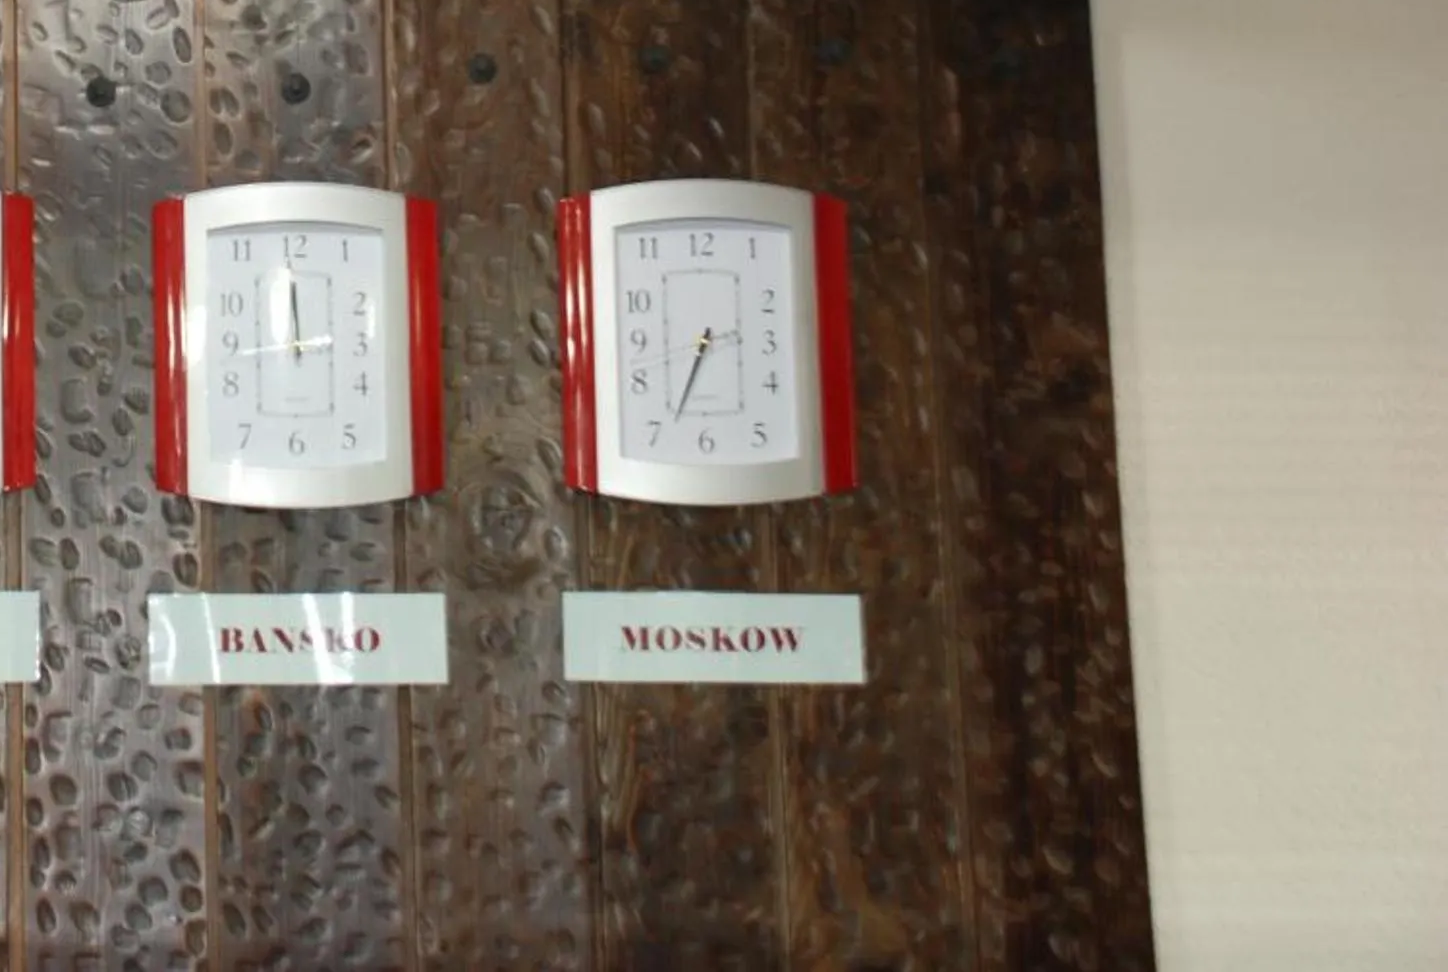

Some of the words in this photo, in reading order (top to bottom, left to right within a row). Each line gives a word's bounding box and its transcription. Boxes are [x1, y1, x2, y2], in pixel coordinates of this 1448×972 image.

[231, 239, 252, 262] 11
[282, 235, 307, 259] 12
[341, 239, 349, 262] 1
[638, 237, 658, 259] 11
[688, 233, 715, 257] 12
[748, 237, 757, 259] 1
[220, 292, 243, 317] 10
[353, 292, 367, 315] 2
[627, 290, 651, 314] 10
[761, 289, 775, 314] 2
[222, 333, 239, 356] 9
[353, 332, 368, 357] 3
[630, 330, 647, 354] 9
[761, 330, 777, 356] 3
[222, 373, 239, 398] 8
[352, 372, 368, 396] 4
[630, 369, 648, 395] 8
[762, 371, 779, 396] 4
[237, 424, 252, 450] 7
[288, 431, 305, 455] 6
[342, 424, 357, 450] 5
[647, 420, 662, 448] 7
[698, 429, 715, 454] 6
[751, 422, 768, 448] 5
[620, 625, 803, 652] MOSKOW
